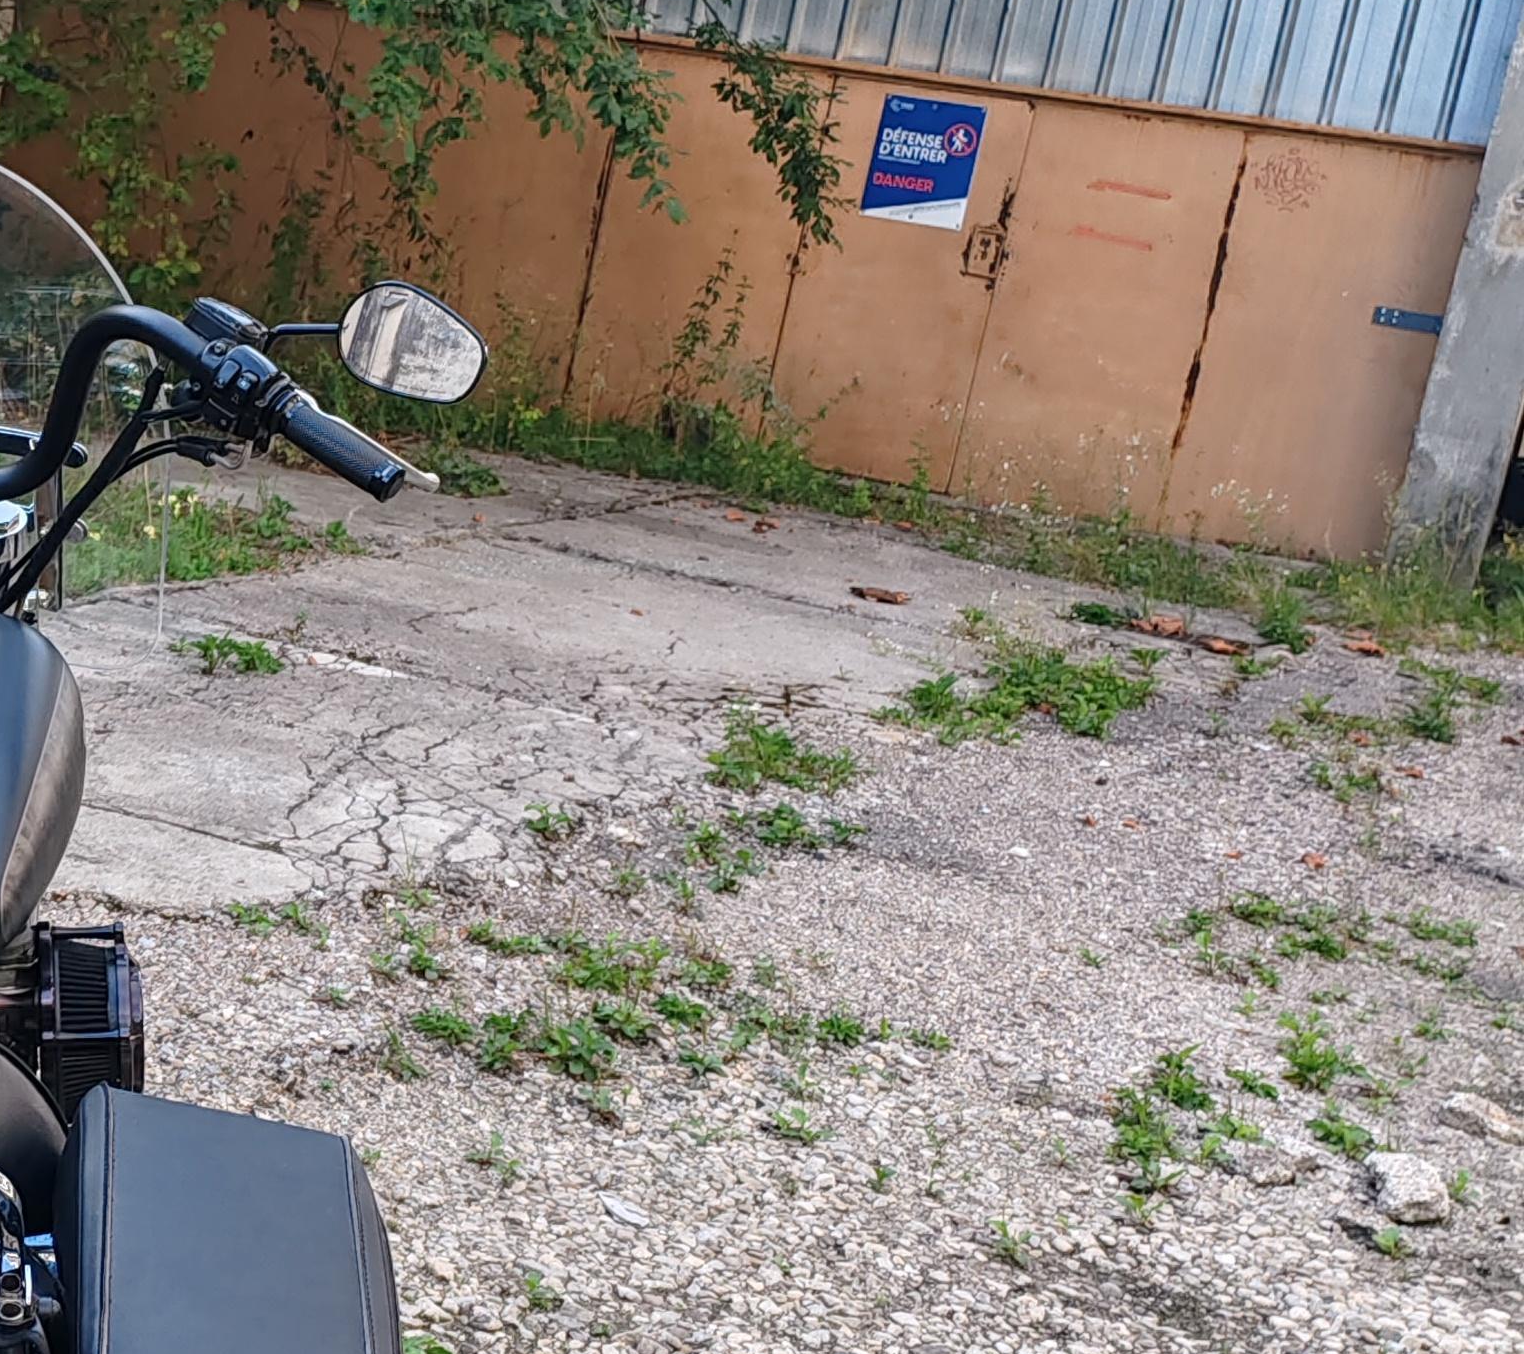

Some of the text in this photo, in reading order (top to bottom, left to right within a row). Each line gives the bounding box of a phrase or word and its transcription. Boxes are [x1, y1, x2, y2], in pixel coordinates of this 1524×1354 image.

[882, 126, 944, 149] DÉFENSE
[879, 141, 948, 164] D'ENTRER
[873, 172, 934, 193] DANGER
